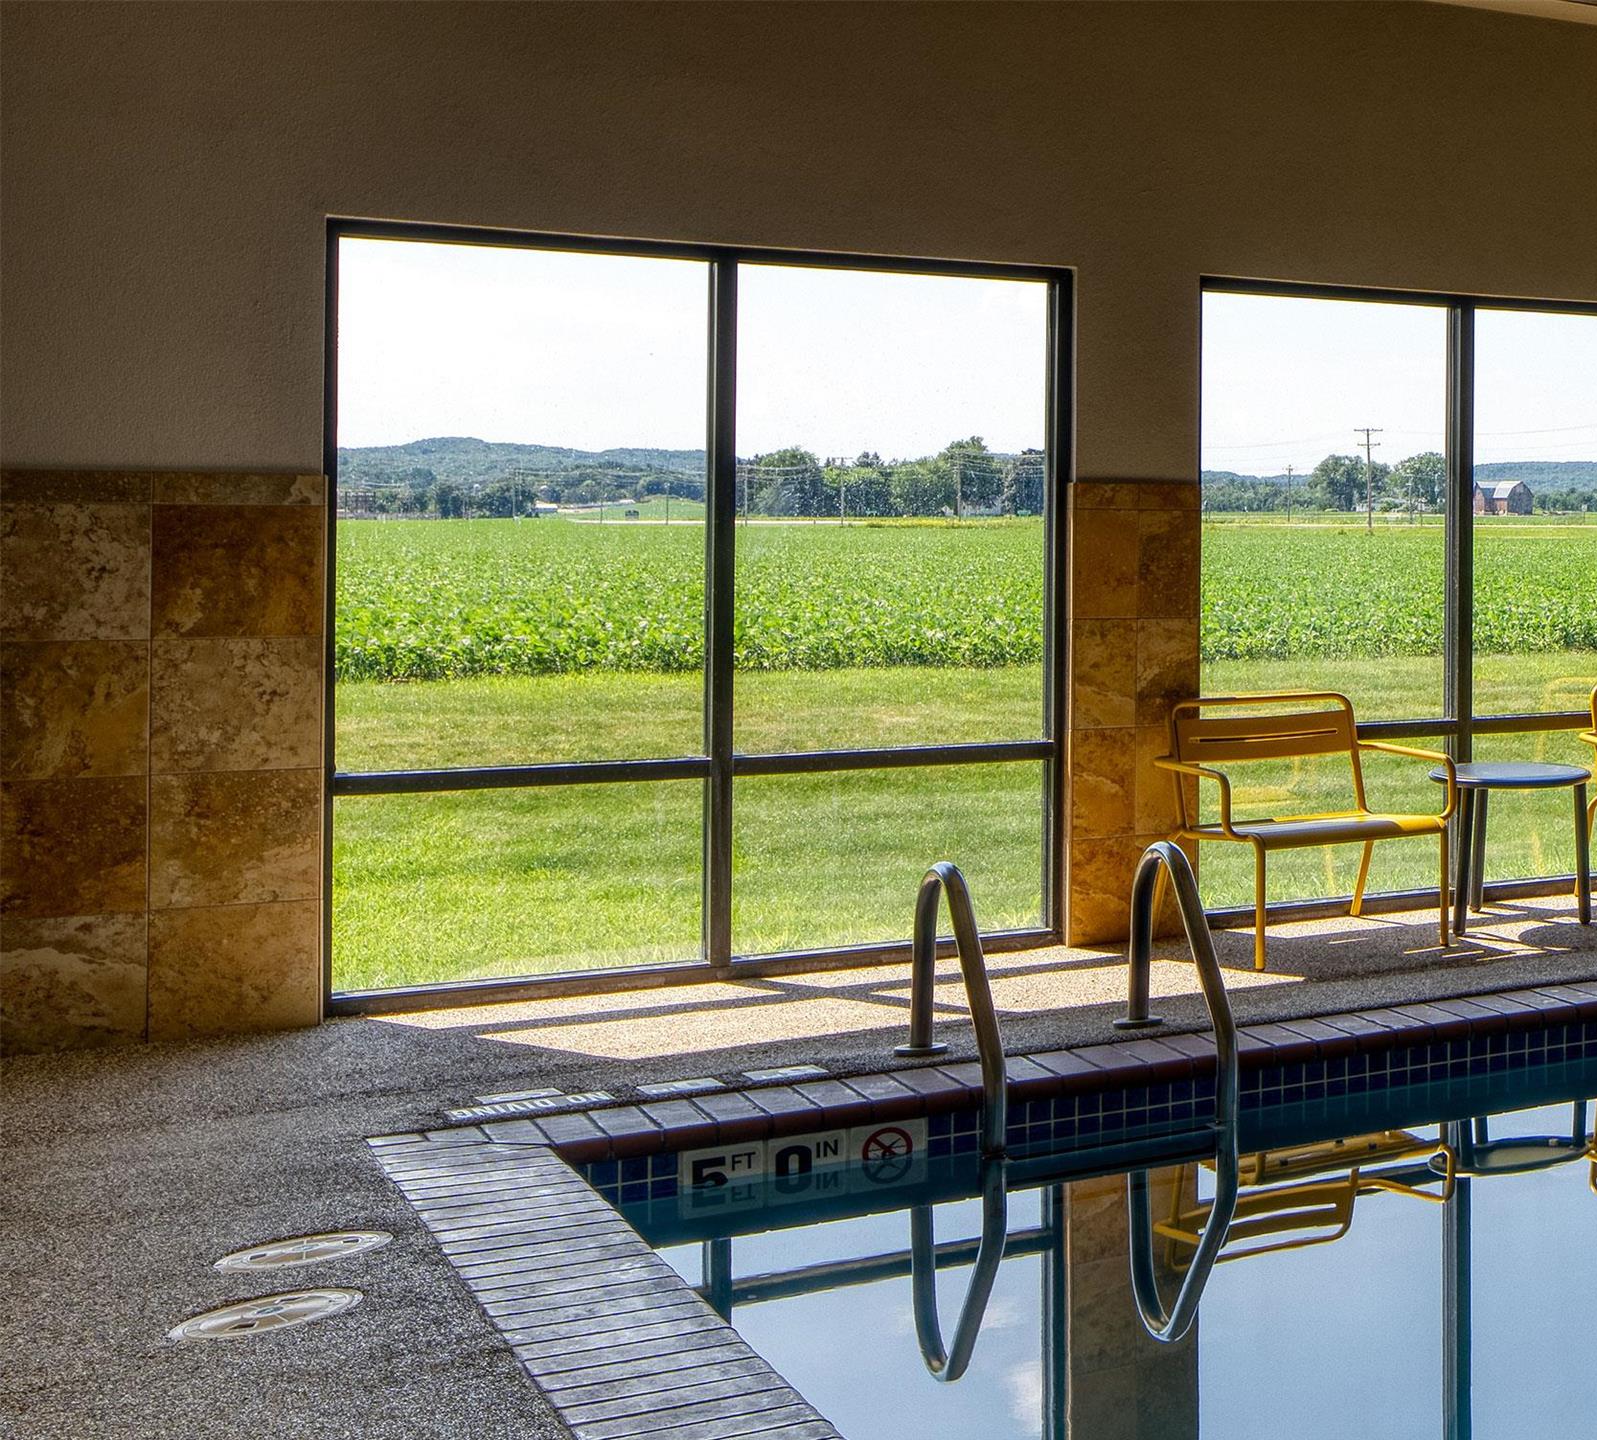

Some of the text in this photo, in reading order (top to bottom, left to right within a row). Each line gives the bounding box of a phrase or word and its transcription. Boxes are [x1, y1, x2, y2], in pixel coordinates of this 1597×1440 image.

[450, 1090, 616, 1119] NO DIVING
[692, 1157, 728, 1190] 5
[732, 1151, 756, 1171] FT
[775, 1145, 812, 1186] 0
[816, 1139, 838, 1158] IN
